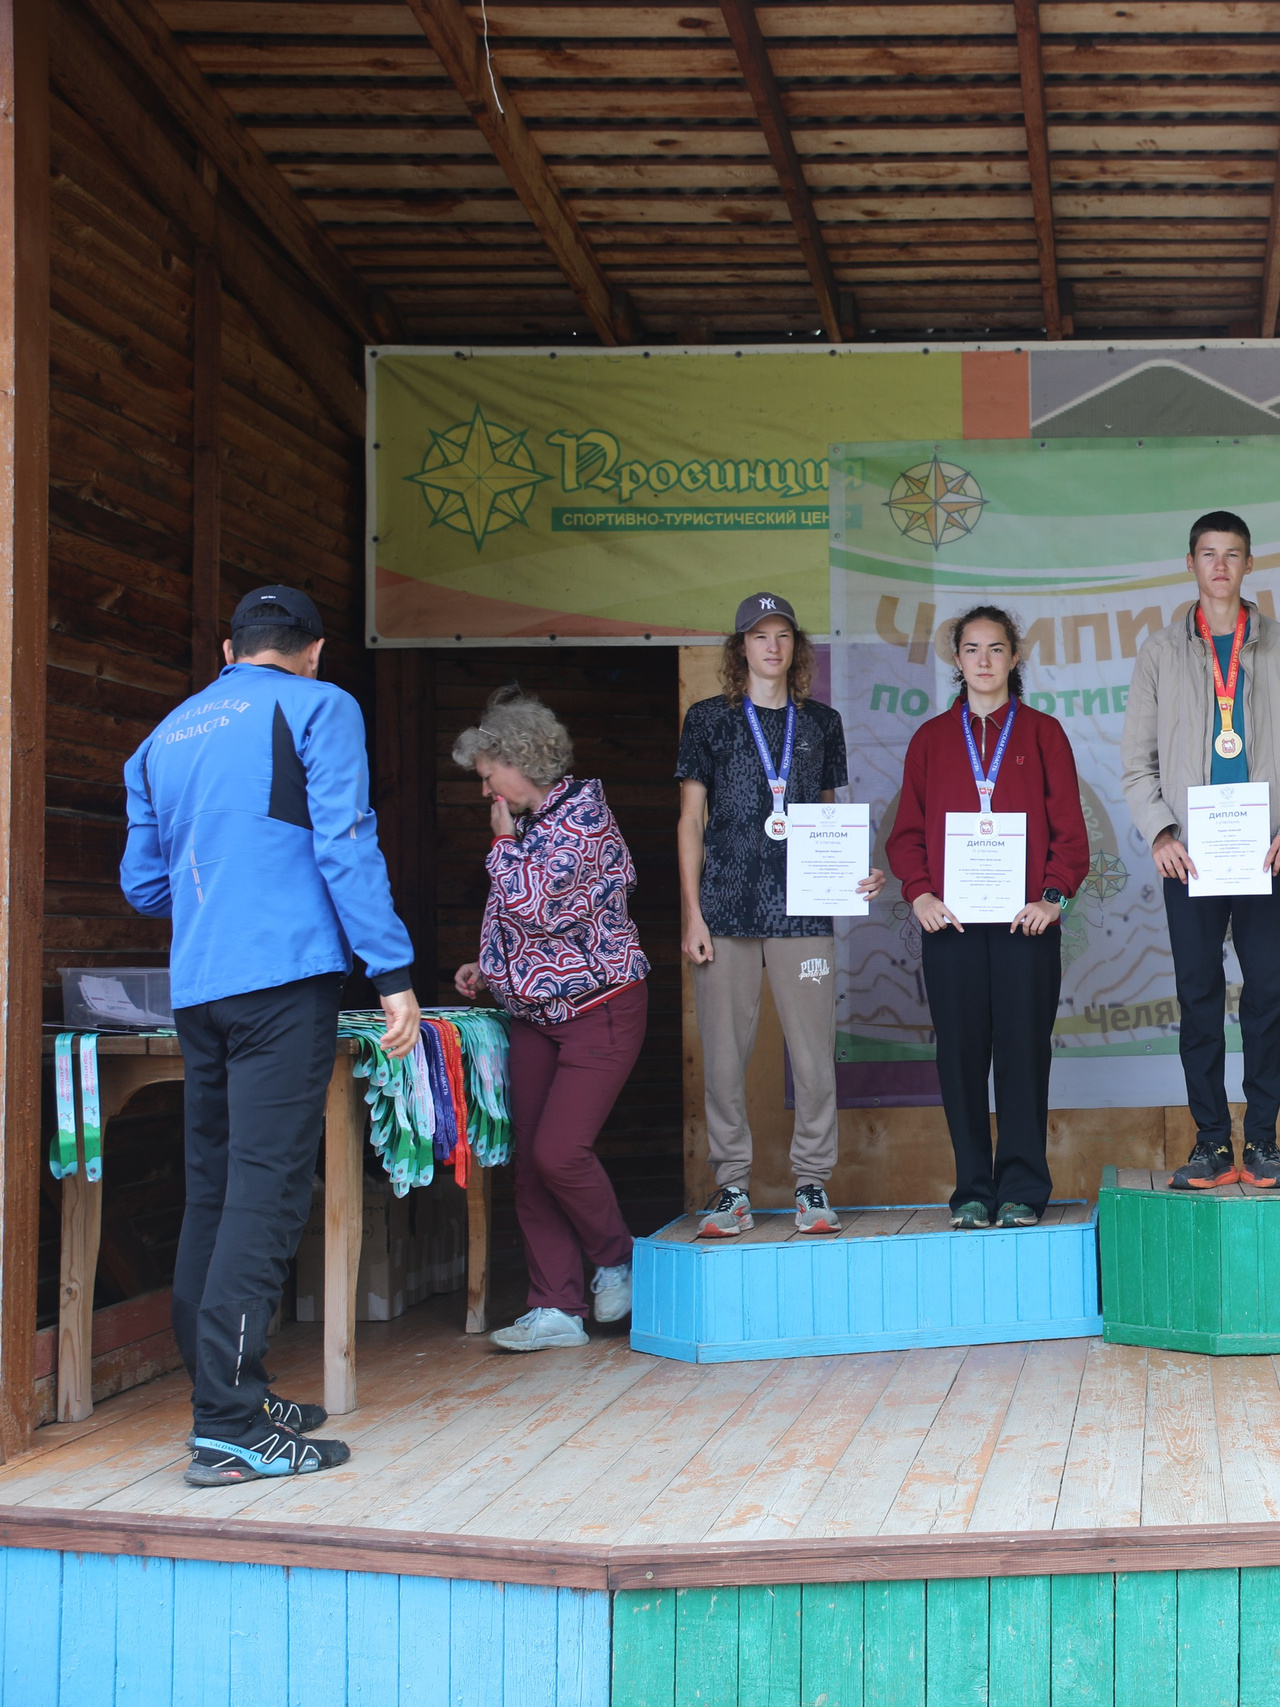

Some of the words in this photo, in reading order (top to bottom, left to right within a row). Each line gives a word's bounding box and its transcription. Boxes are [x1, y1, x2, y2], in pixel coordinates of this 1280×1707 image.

[562, 510, 796, 527] СПОРТИВНО-ТУРИСТИЧЕСКИЙ
[166, 716, 230, 745] ОБЛАСТЬ
[991, 746, 1003, 772] ОБЛАСТЬ
[1080, 795, 1104, 843] 024
[1208, 811, 1248, 820] ДИПЛОМ
[809, 831, 848, 839] ДИПЛОМ
[966, 840, 1005, 848] ДИПЛОМ
[800, 957, 829, 973] PUMA
[440, 1067, 449, 1096] ОБЛАСТЬ
[208, 1441, 244, 1454] SALOMON
